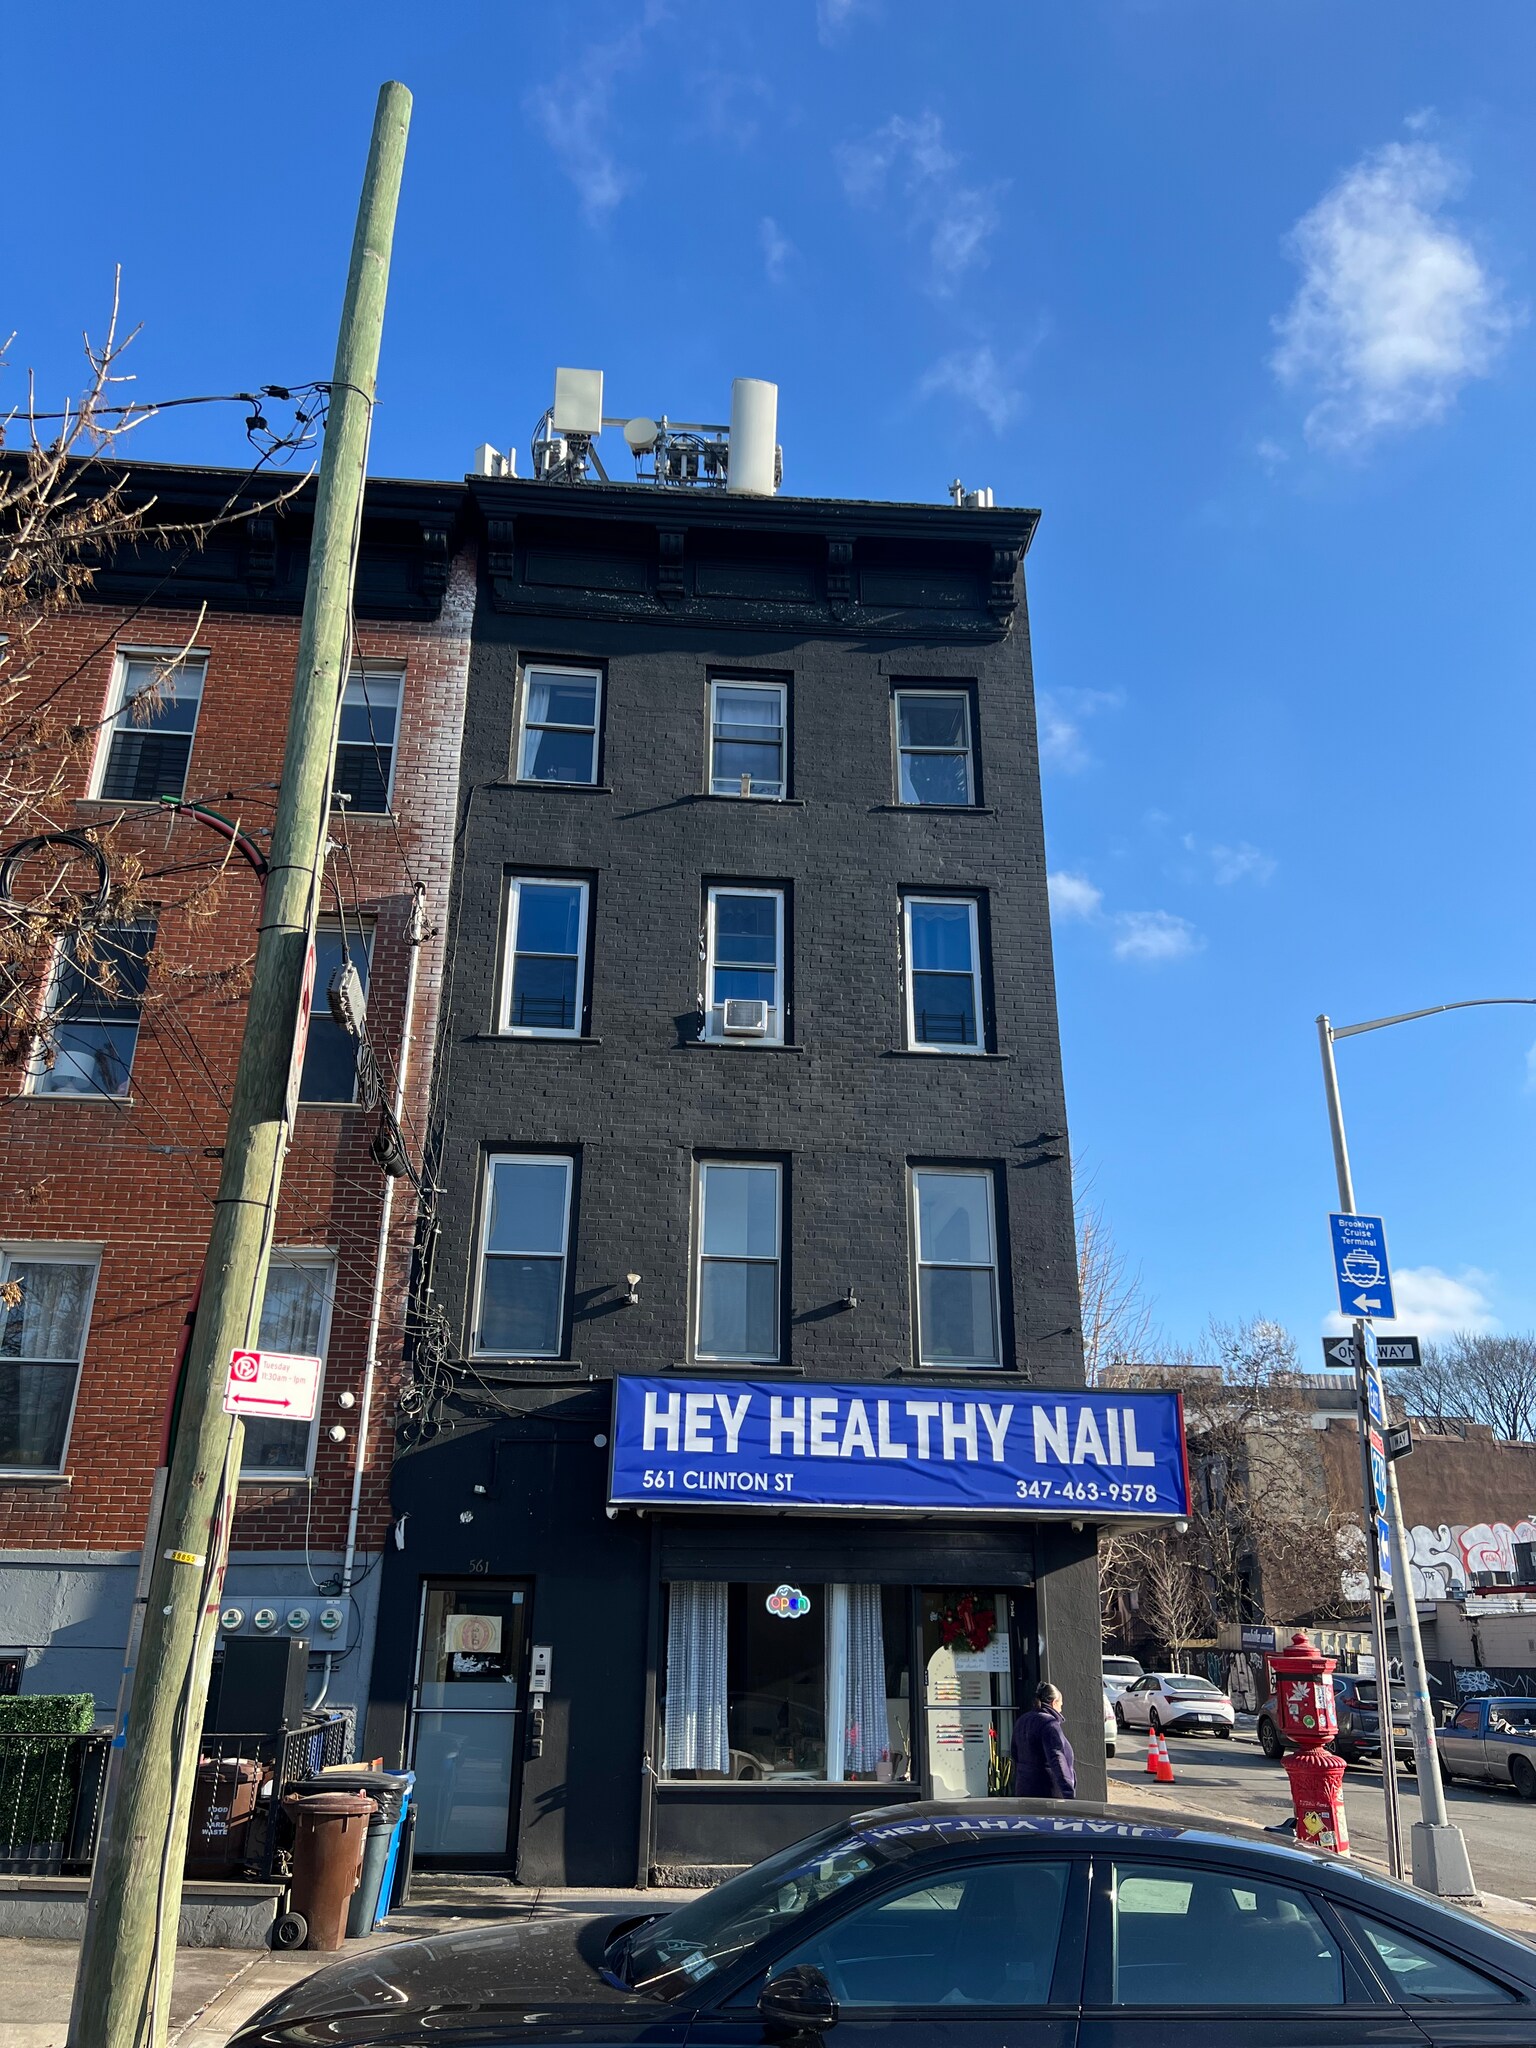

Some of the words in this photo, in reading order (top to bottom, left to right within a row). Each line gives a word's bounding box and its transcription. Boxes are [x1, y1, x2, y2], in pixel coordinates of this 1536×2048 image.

[1338, 1219, 1375, 1230] Brooklyn
[1344, 1228, 1372, 1238] Cruise
[1341, 1236, 1377, 1247] Terminal
[1378, 1346, 1406, 1358] WAY
[264, 1360, 290, 1373] Tuesday
[262, 1372, 288, 1382] 11:30am
[643, 1391, 753, 1453] HEY
[769, 1396, 1014, 1461] HEALTHY
[1033, 1406, 1155, 1466] NAIL
[642, 1469, 675, 1489] 561
[683, 1470, 768, 1491] CLINTON
[774, 1472, 794, 1492] ST
[1016, 1480, 1157, 1503] 347-463-9578
[469, 1559, 489, 1574] 561
[770, 1597, 806, 1611] open
